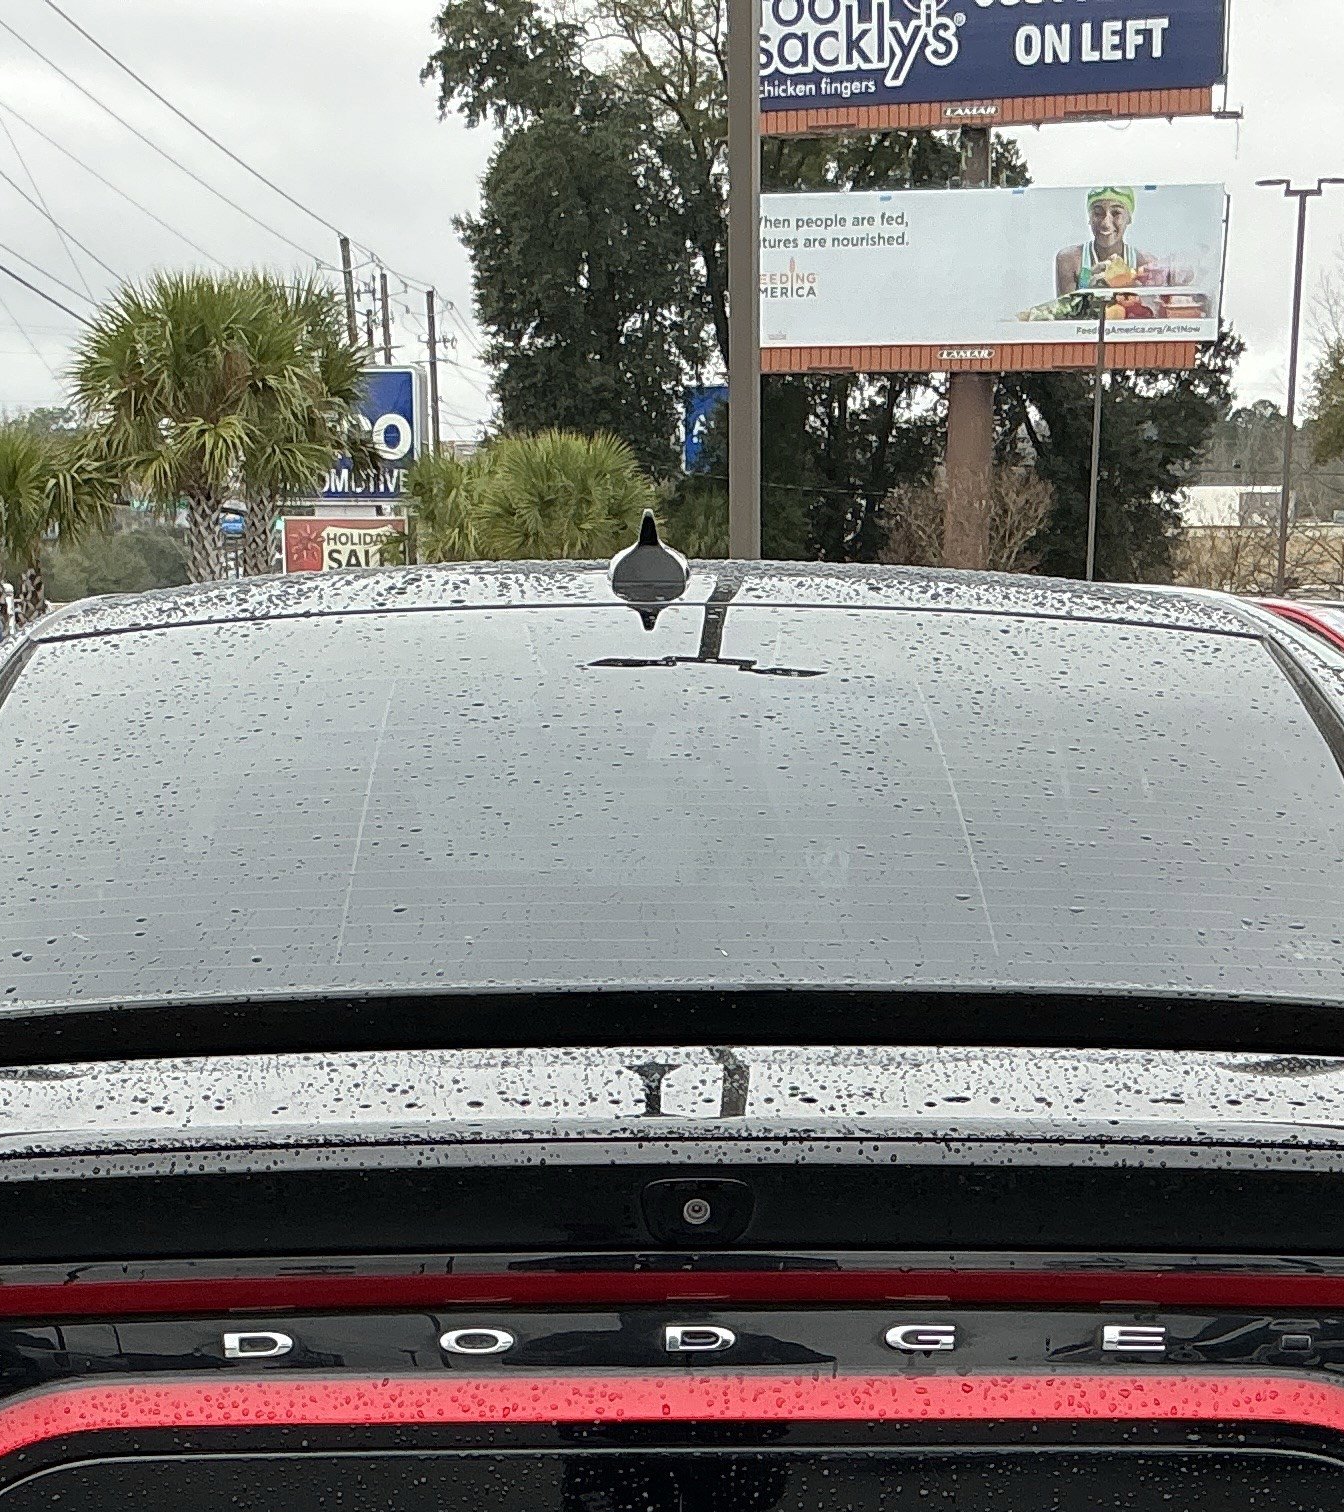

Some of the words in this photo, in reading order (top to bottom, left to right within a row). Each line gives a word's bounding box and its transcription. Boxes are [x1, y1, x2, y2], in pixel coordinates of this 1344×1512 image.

[1014, 23, 1071, 66] ON
[1081, 16, 1169, 62] LEFT
[821, 77, 876, 98] fingers
[944, 105, 997, 117] LAMAR
[760, 215, 791, 229] hen
[795, 213, 847, 231] people
[851, 215, 876, 228] are
[880, 211, 909, 227] fed,
[760, 234, 799, 249] tures
[803, 237, 827, 249] are
[831, 231, 910, 248] nourished.
[760, 270, 817, 285] EEDING
[760, 286, 817, 299] MERICA
[941, 349, 991, 359] LAMAR
[326, 532, 391, 546] HOLIDA
[223, 1325, 1166, 1357] DODGE
